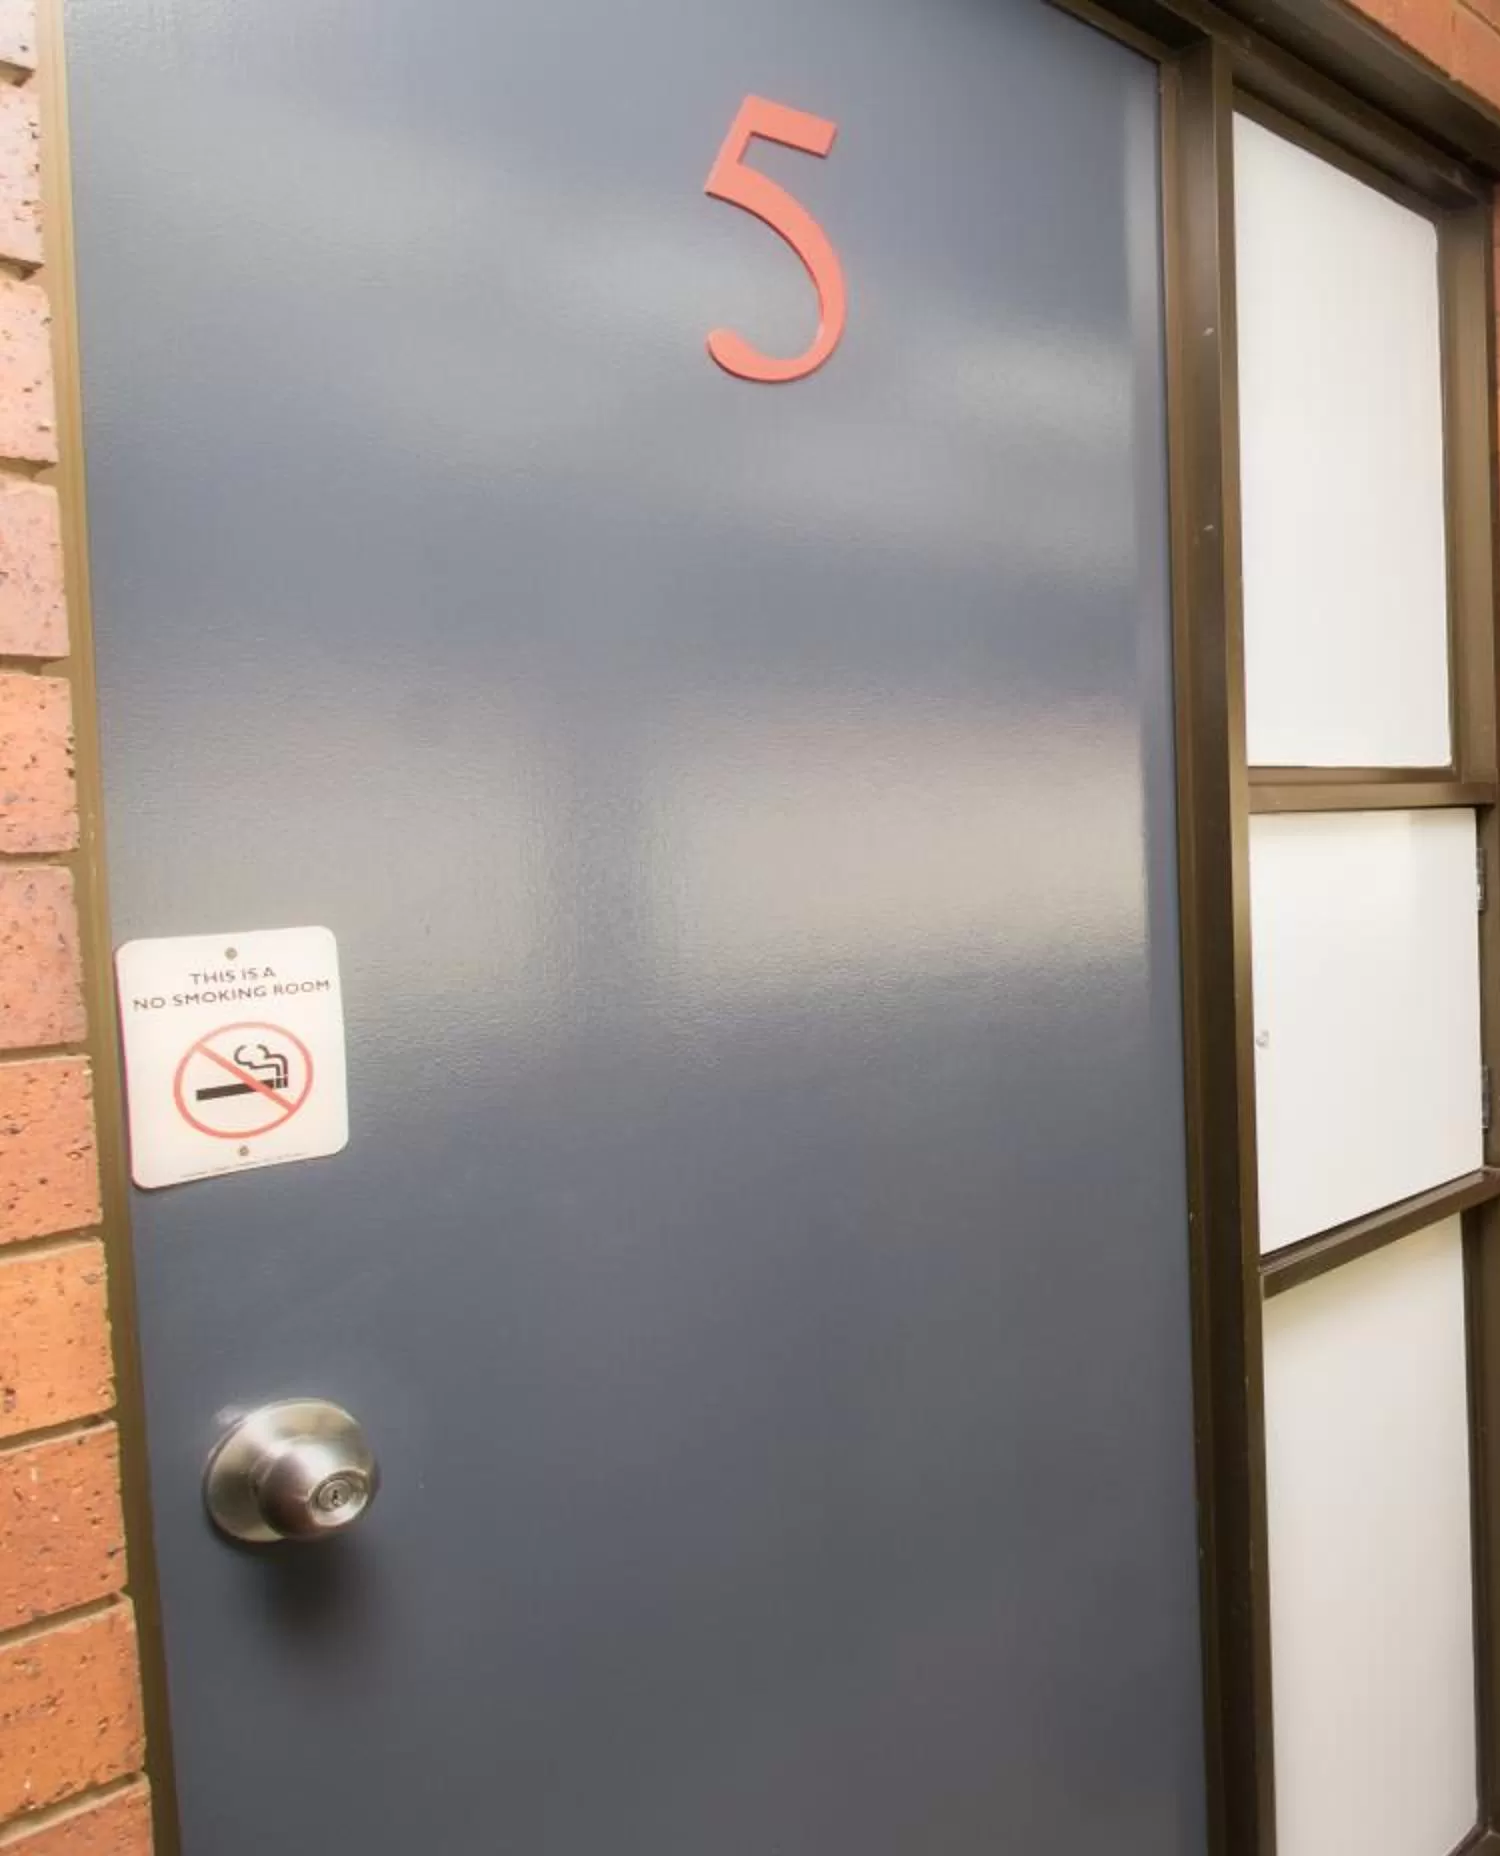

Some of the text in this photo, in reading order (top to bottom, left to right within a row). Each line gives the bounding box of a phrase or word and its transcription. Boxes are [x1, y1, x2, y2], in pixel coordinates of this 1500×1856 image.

[703, 94, 846, 384] 5
[189, 966, 277, 985] THIS IS A
[132, 979, 331, 1012] NO SMOKING ROOM
